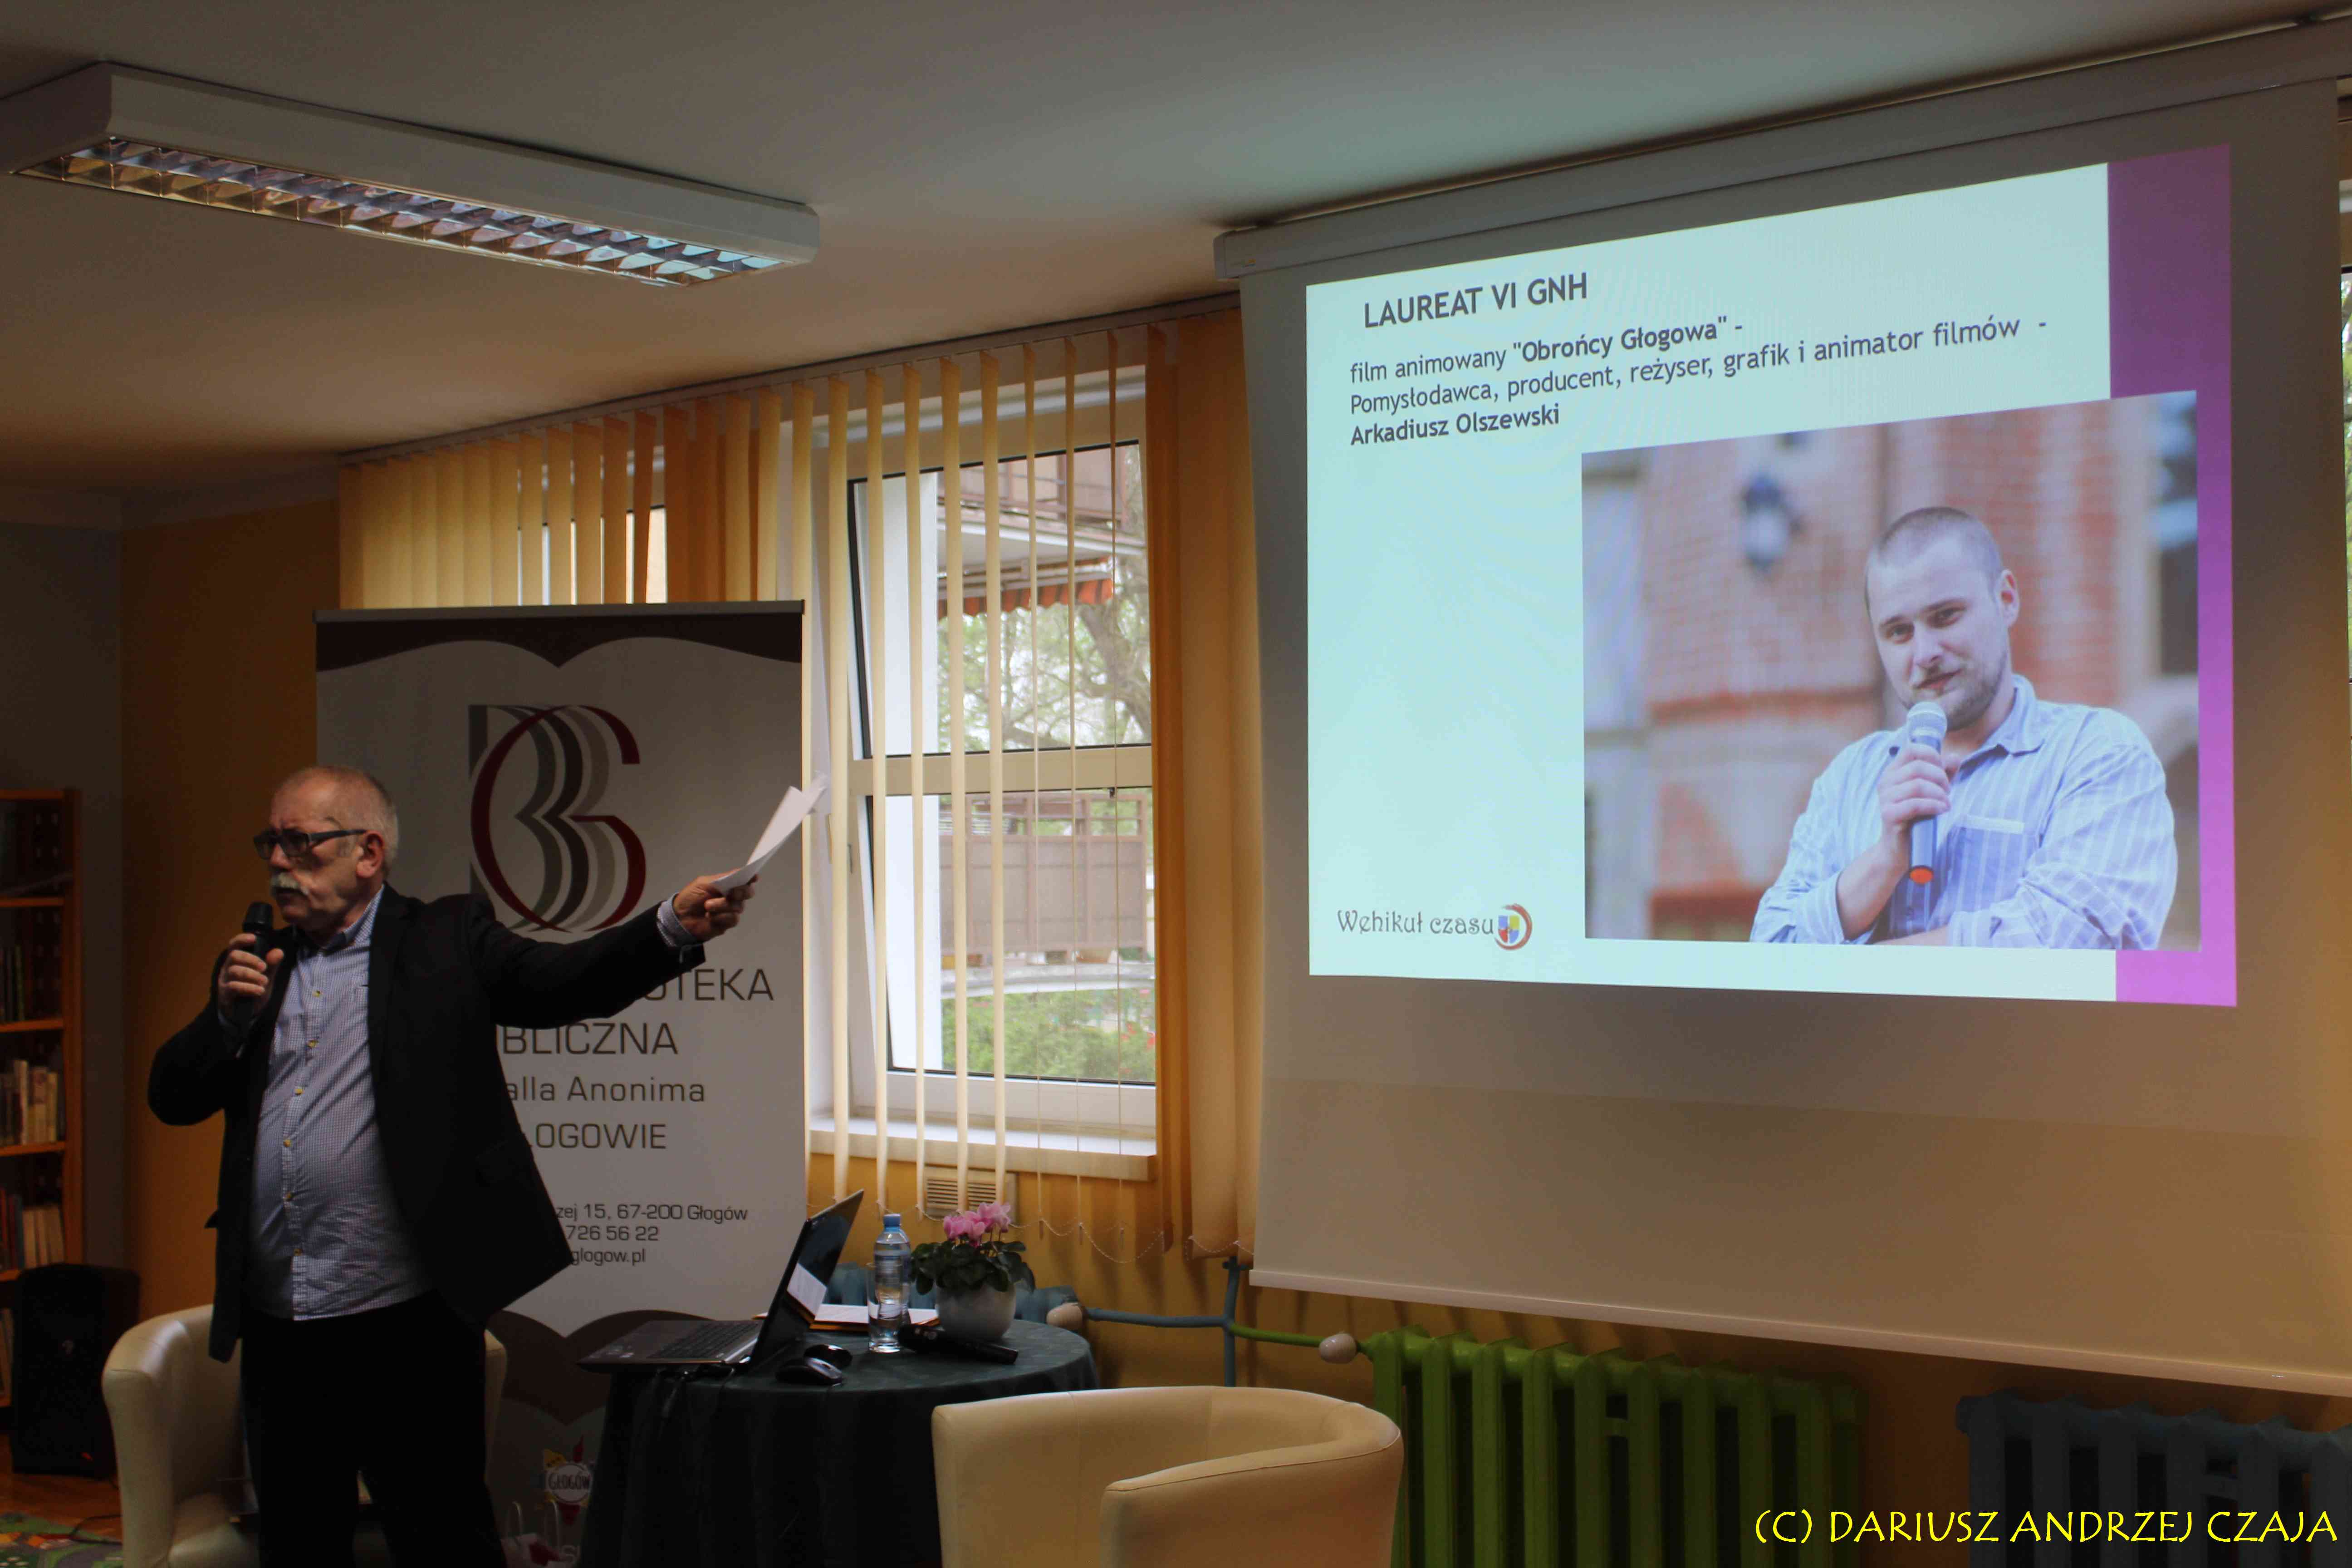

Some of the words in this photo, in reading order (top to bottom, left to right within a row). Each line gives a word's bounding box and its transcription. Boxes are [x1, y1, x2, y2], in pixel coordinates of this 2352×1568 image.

[1365, 287, 1483, 328] LAUREAT
[1491, 282, 1516, 310] VI
[1528, 272, 1587, 304] GNH
[1351, 362, 1387, 383] film
[1396, 349, 1506, 378] animowany
[1514, 335, 1613, 362] "Obrońcy
[1622, 316, 1726, 351] Głogowa"
[1351, 384, 1498, 415] Pomysłodawca,
[1508, 366, 1621, 402] producent,
[1631, 356, 1713, 384] reżyser,
[1723, 343, 1790, 377] grafik
[1798, 340, 1805, 363] i
[1815, 328, 1923, 361] animator
[1933, 315, 2020, 348] filmów
[1351, 419, 1449, 445] Arkadiusz
[1457, 404, 1559, 433] Olszewski
[1430, 917, 1494, 935] czasu
[567, 1076, 705, 1102] Anonima
[530, 1123, 666, 1149] OGOWIE
[617, 1204, 682, 1220] 67-200
[687, 1205, 748, 1224] Głogów
[566, 1225, 601, 1240] 726
[606, 1225, 629, 1241] 56
[635, 1226, 659, 1241] 22
